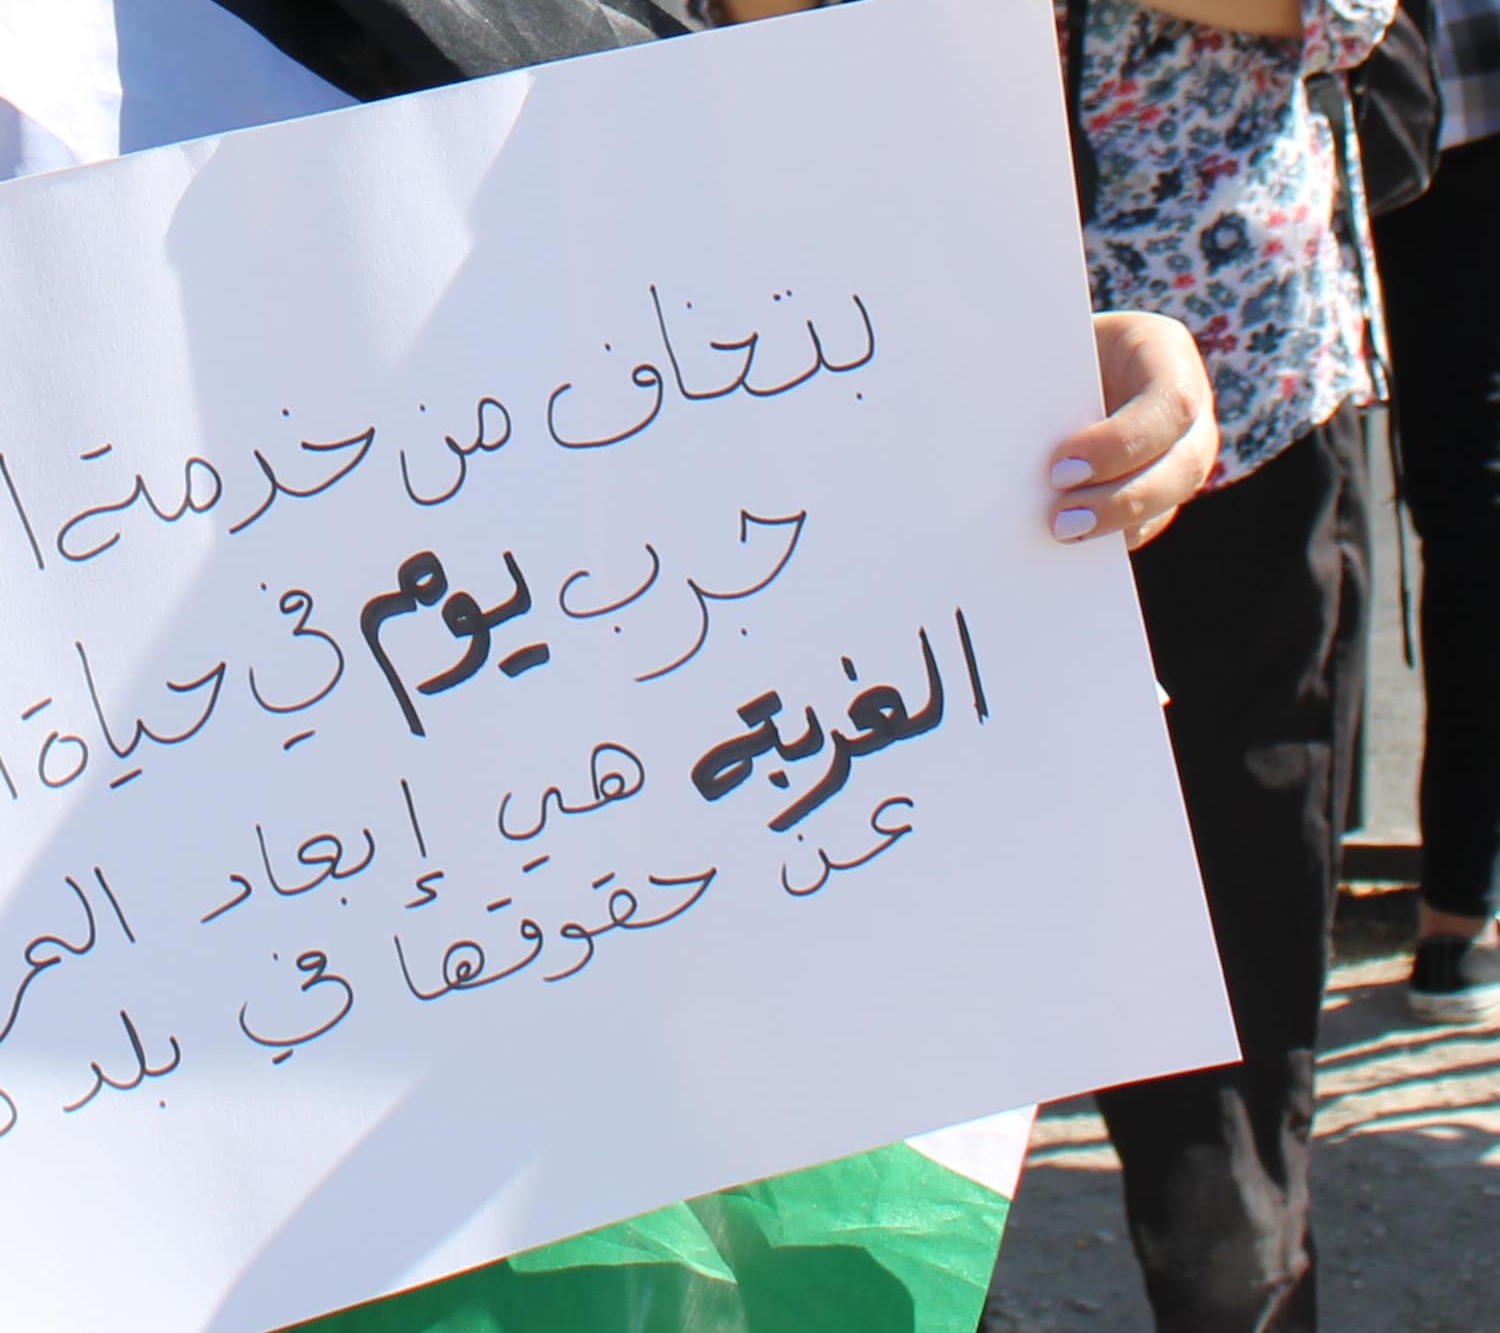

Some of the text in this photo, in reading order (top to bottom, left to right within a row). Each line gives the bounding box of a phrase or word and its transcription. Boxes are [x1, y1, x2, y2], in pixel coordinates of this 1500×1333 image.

[547, 283, 876, 450] بتخاف
[56, 409, 376, 564] خدمة
[399, 396, 512, 507] من
[248, 582, 345, 752] في
[359, 549, 552, 739] يوم
[558, 508, 808, 684] جرب
[19, 640, 227, 790] حياة
[690, 606, 990, 834] الغربة
[200, 778, 446, 924] إبعاد
[497, 742, 646, 874] هي
[780, 796, 915, 899] عن
[238, 950, 354, 1066] في
[393, 866, 718, 1002] حقوقها
